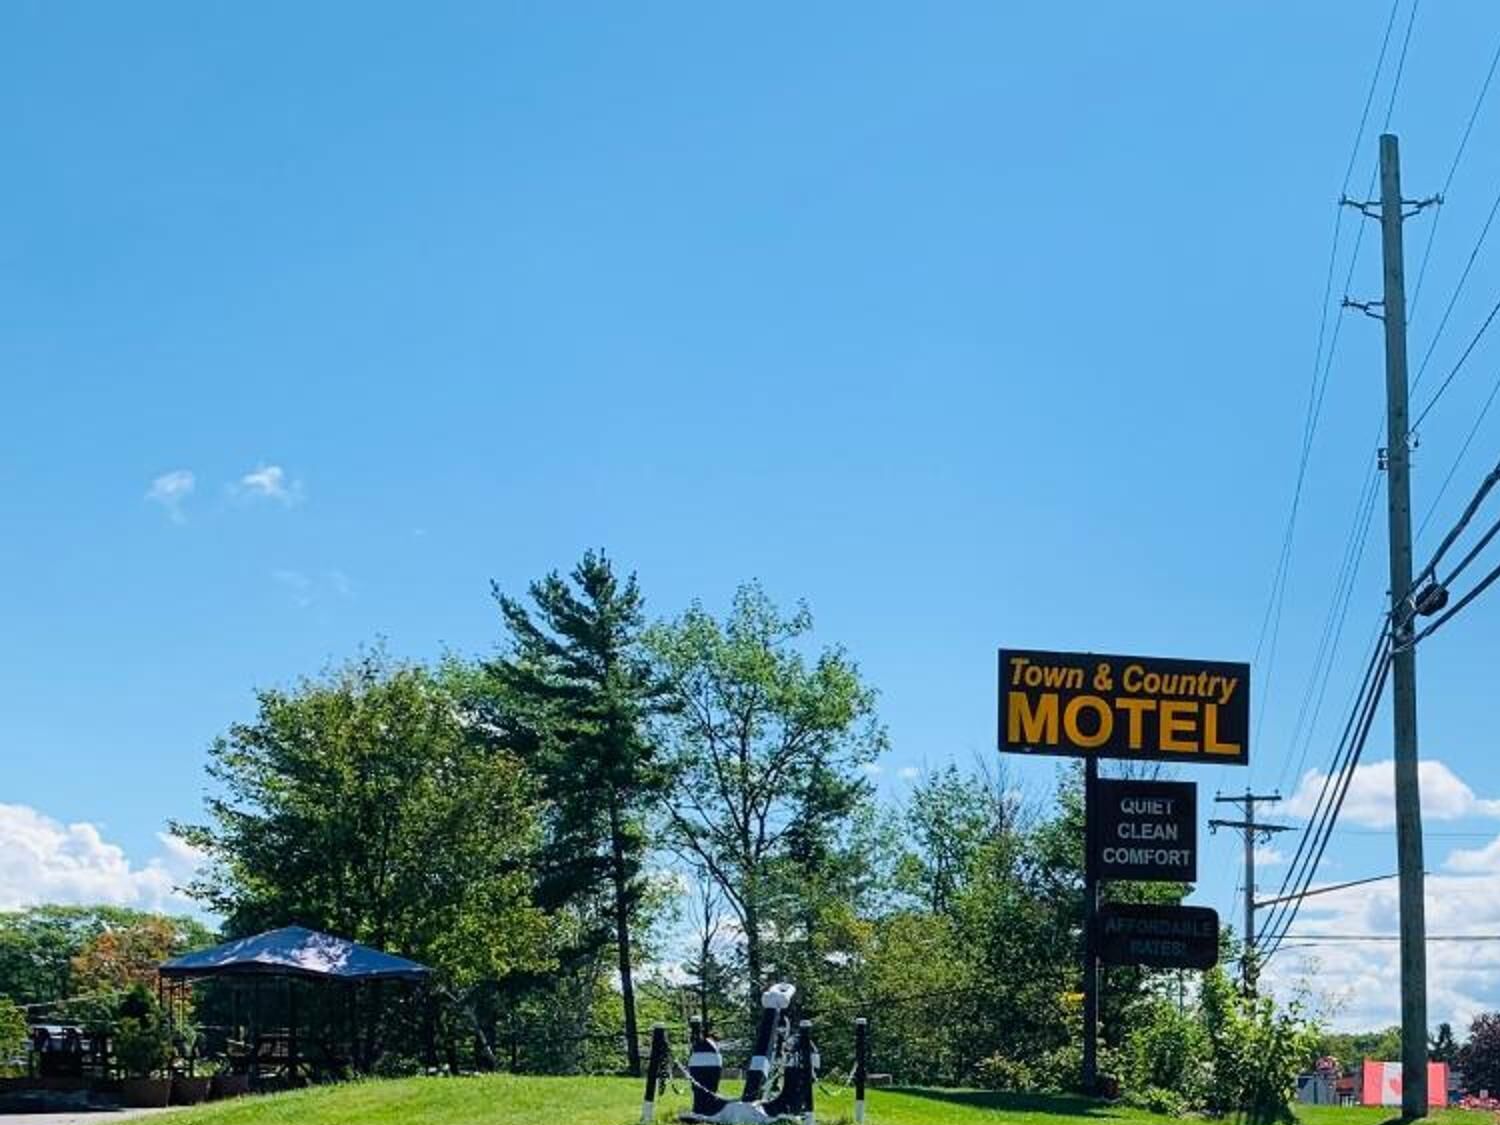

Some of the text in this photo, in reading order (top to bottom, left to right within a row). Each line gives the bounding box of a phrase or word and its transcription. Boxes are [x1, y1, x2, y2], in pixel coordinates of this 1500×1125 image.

[1010, 657, 1237, 704] Town & Country
[1007, 691, 1241, 755] MOTEL
[1120, 798, 1173, 815] QUIET
[1118, 823, 1178, 839] CLEAN
[1103, 847, 1191, 866] COMFORT
